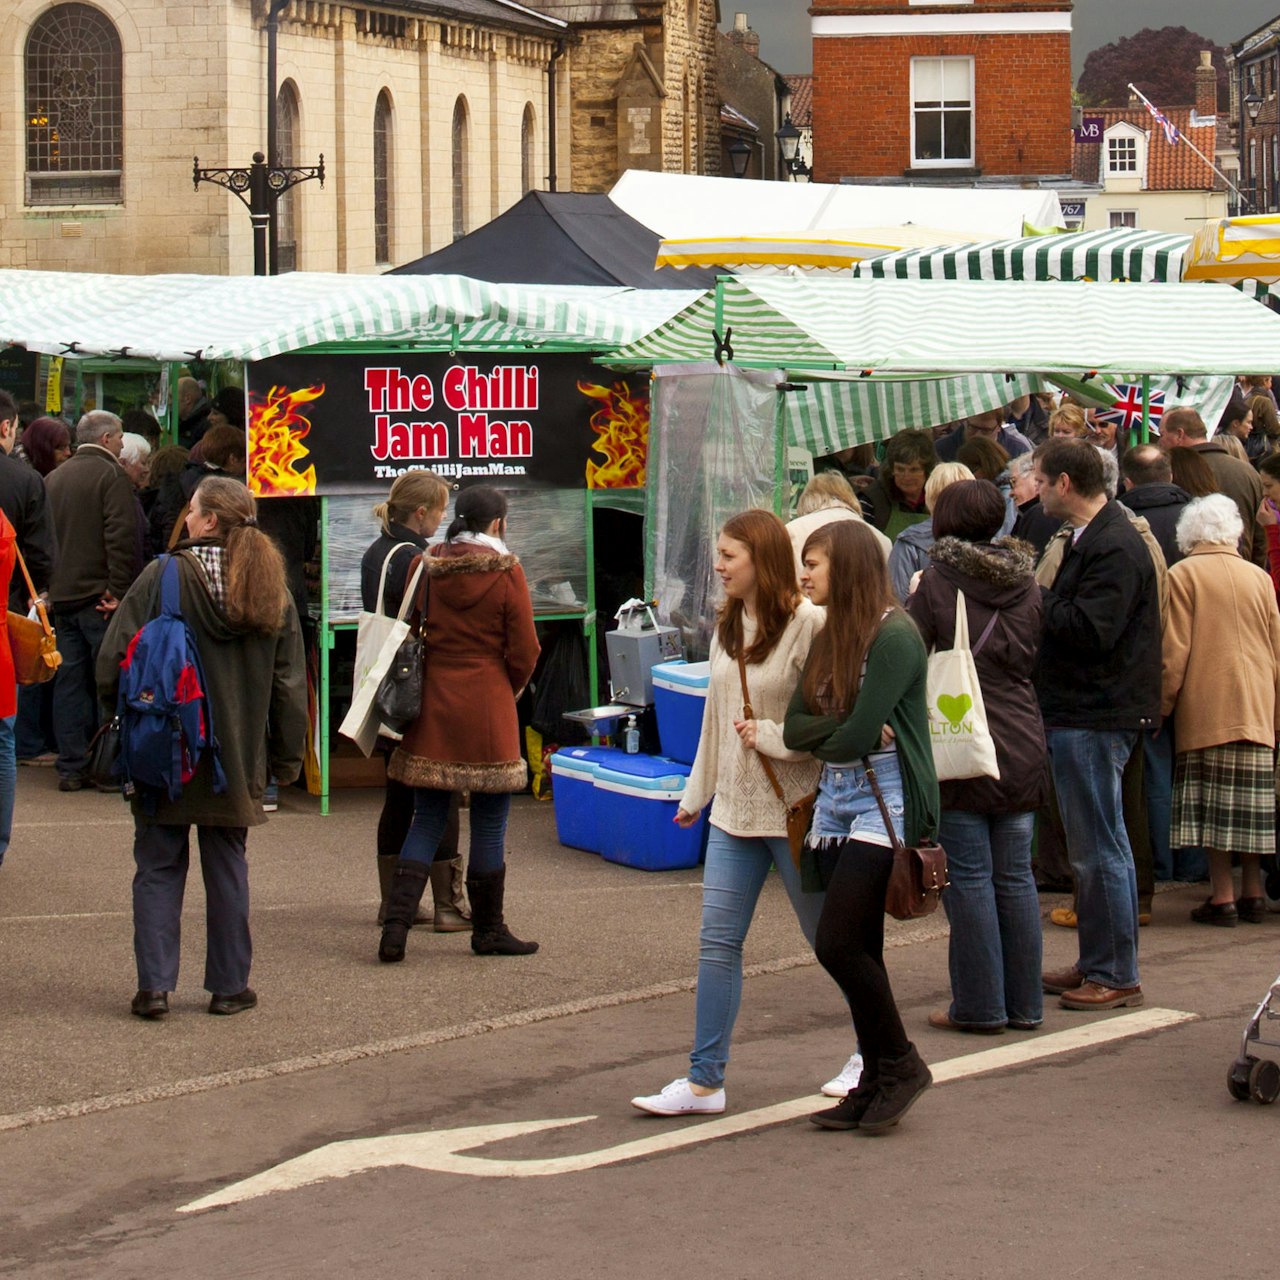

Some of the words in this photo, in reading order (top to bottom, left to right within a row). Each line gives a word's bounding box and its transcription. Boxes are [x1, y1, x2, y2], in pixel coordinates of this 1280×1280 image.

[364, 367, 434, 413] The
[442, 365, 539, 412] Chilli
[370, 414, 450, 461] Jam
[458, 413, 533, 459] Man
[930, 721, 973, 735] LTON
